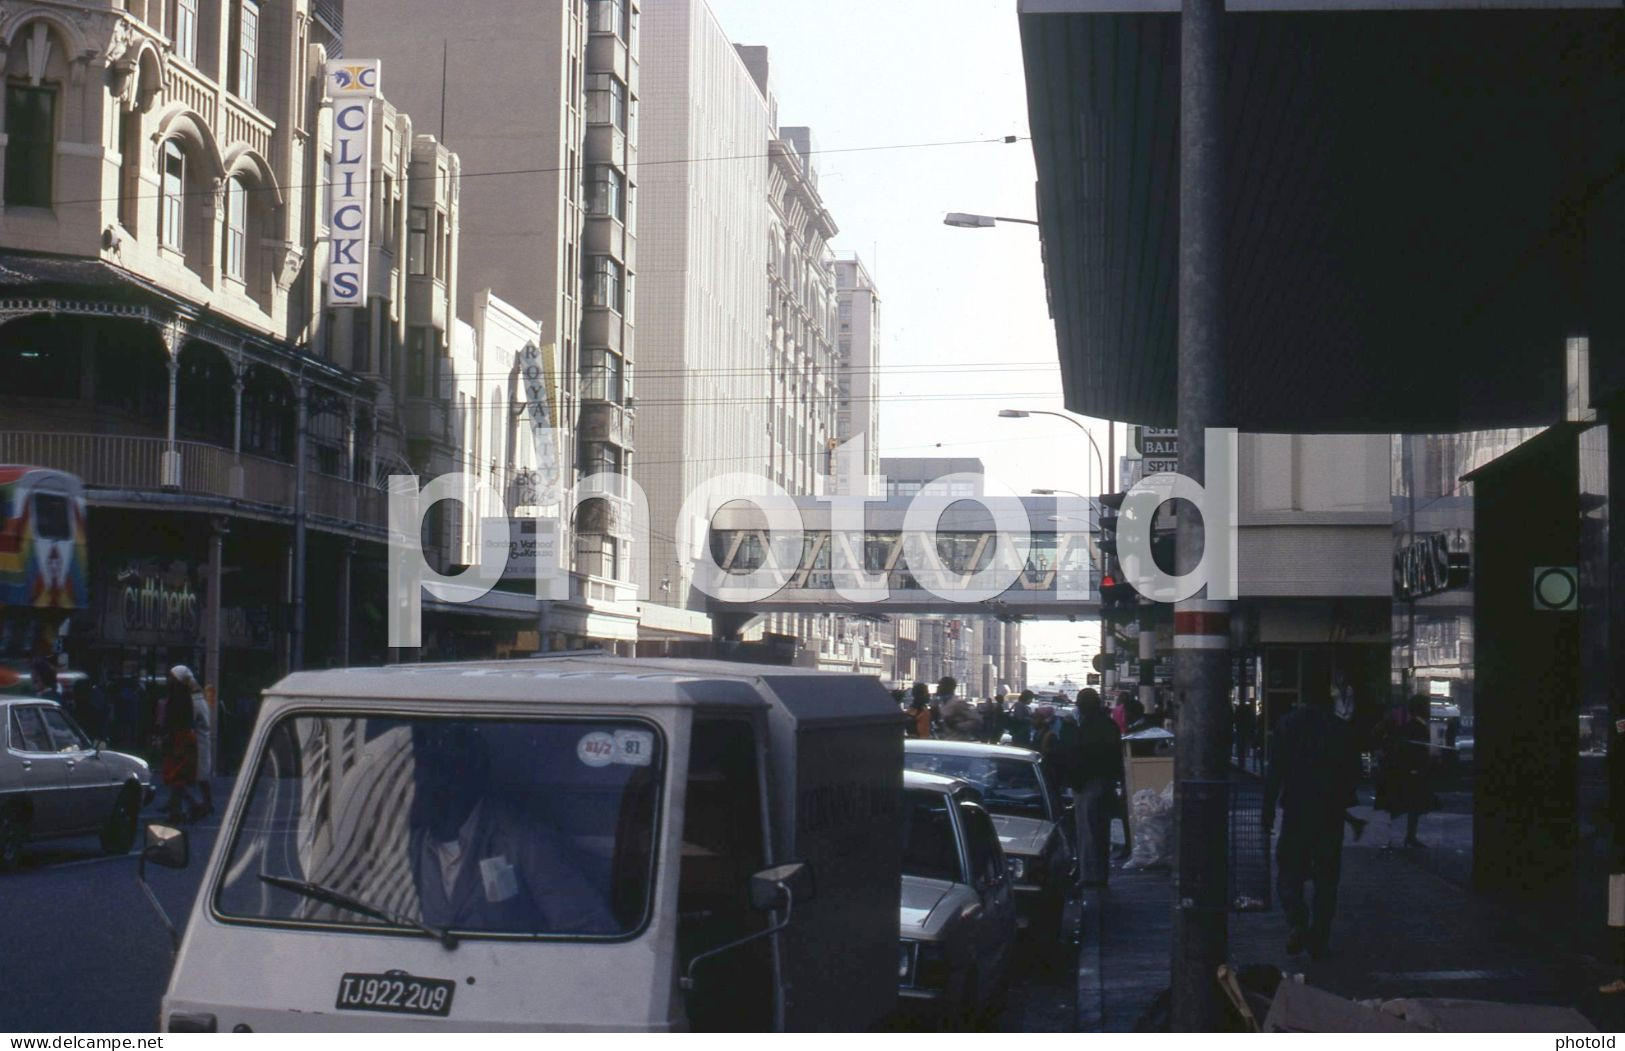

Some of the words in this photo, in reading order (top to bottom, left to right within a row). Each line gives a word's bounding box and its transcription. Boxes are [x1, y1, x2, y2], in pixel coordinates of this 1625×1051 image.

[332, 105, 365, 298] CLICKS
[525, 345, 557, 477] ROYALTY
[625, 741, 640, 755] 81
